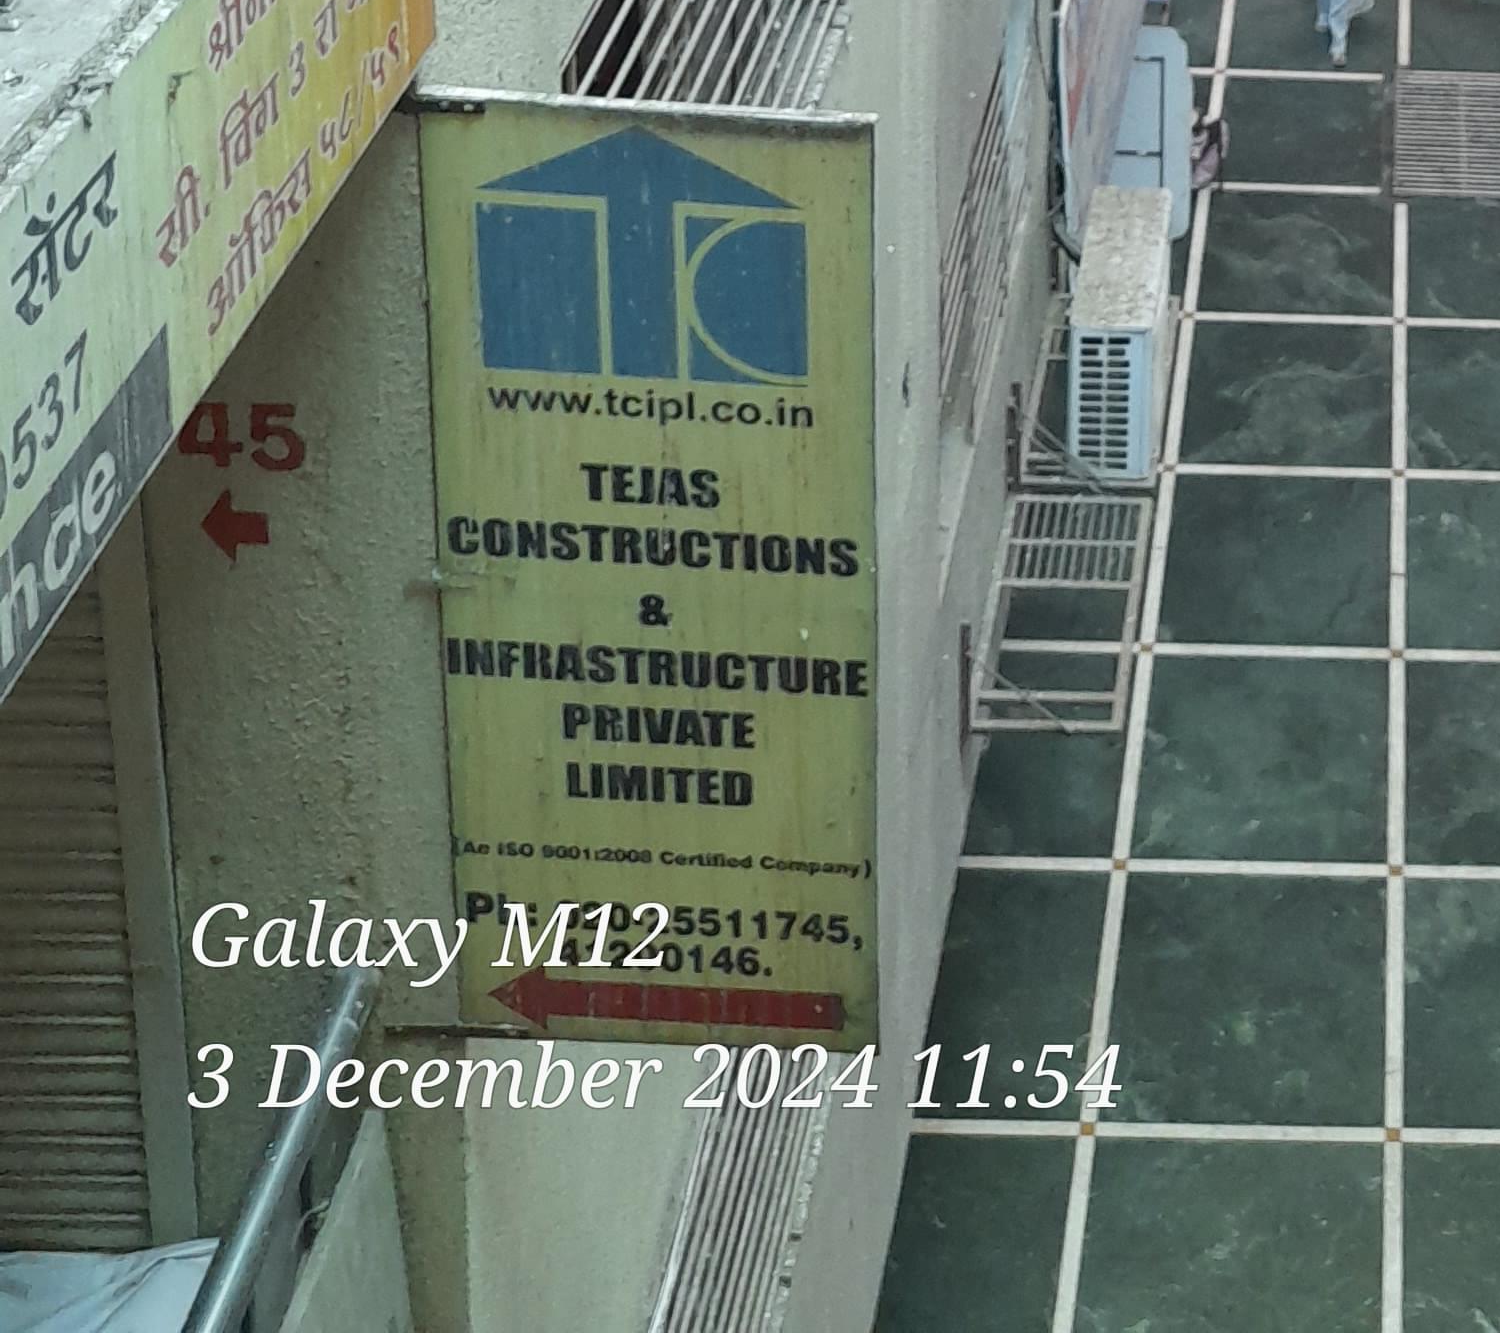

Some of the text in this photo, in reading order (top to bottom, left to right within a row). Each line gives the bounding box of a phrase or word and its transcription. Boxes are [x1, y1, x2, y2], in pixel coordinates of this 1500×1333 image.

[487, 384, 815, 430] www.tcipl.co.in
[178, 402, 306, 471] 45
[580, 462, 721, 509] TEJAS
[446, 515, 859, 578] CONSTRUCTIONS
[639, 593, 671, 627] &
[446, 637, 869, 698] INFRASTRUCTURE
[561, 702, 756, 749] PRIVATE
[565, 762, 754, 806] LIMITED
[498, 842, 534, 859] ISO
[660, 850, 753, 870] Certified
[759, 855, 872, 880] Company)
